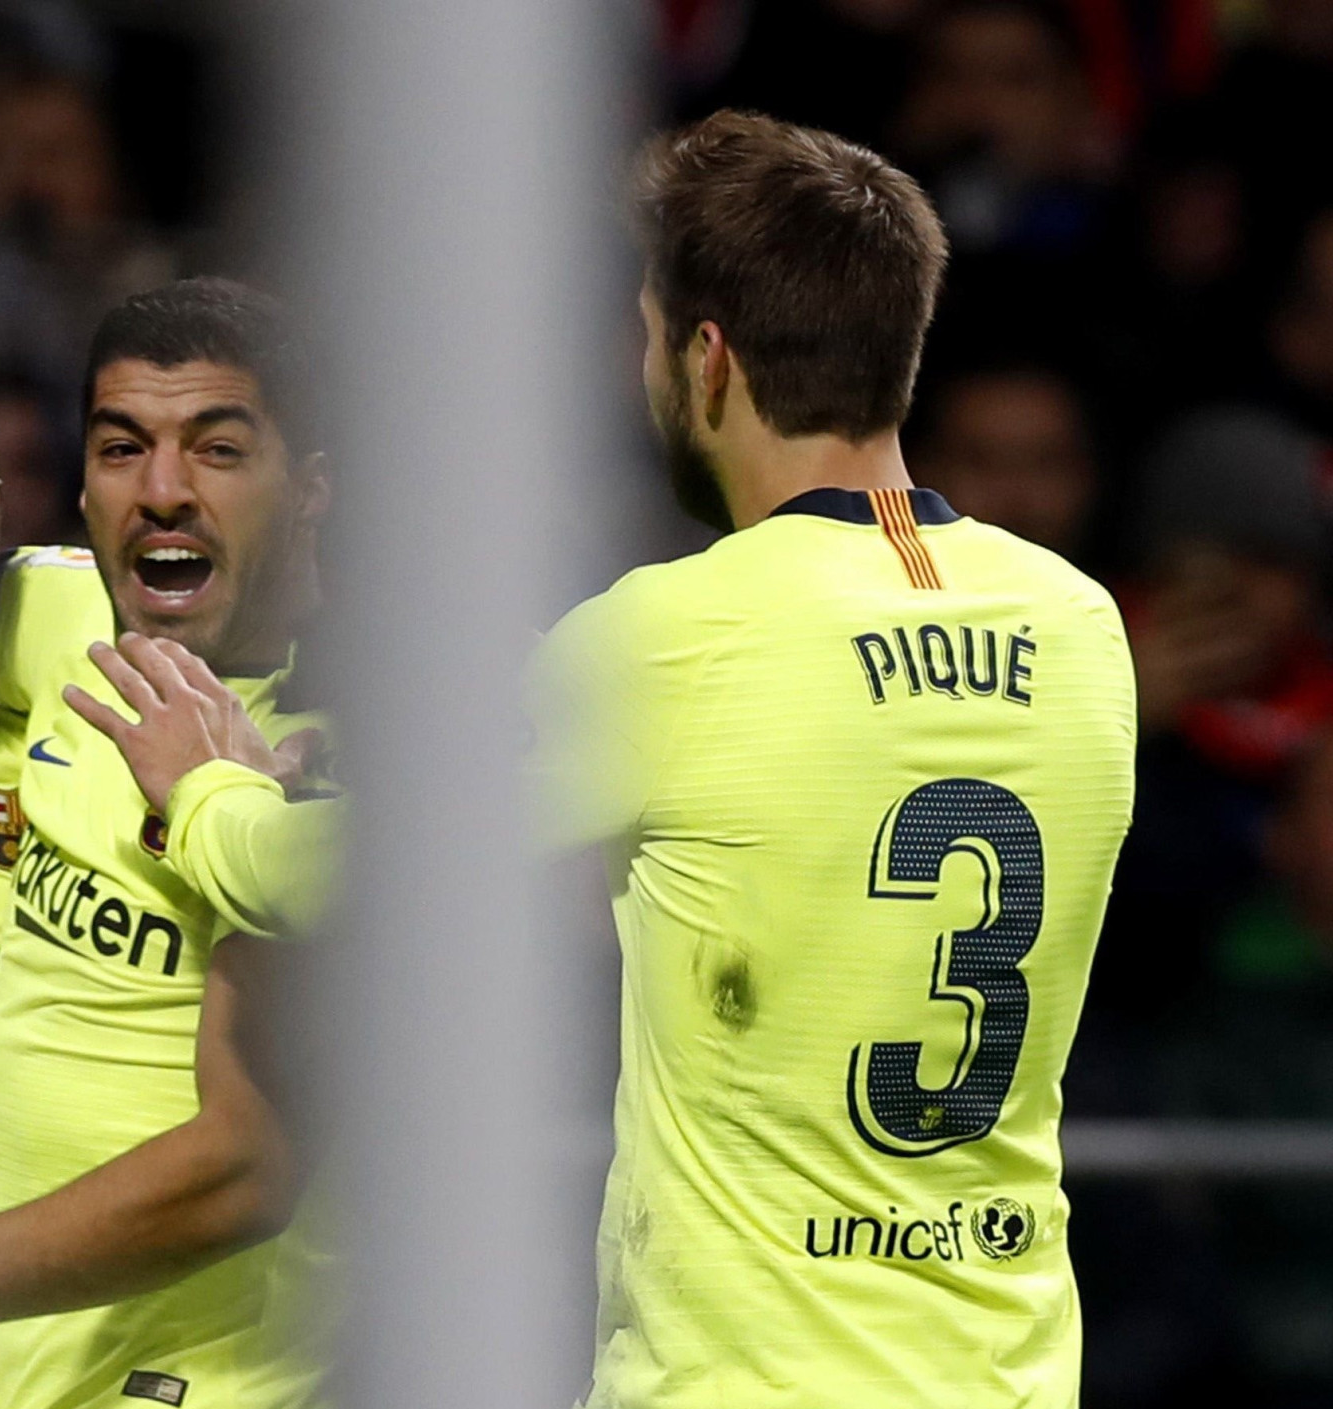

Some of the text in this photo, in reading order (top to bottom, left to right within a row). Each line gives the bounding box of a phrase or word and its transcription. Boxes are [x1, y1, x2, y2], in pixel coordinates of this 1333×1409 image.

[850, 624, 1037, 707] PIQUÉ
[11, 822, 183, 977] akuten
[846, 777, 1045, 1159] 3
[805, 1201, 965, 1262] unicef
